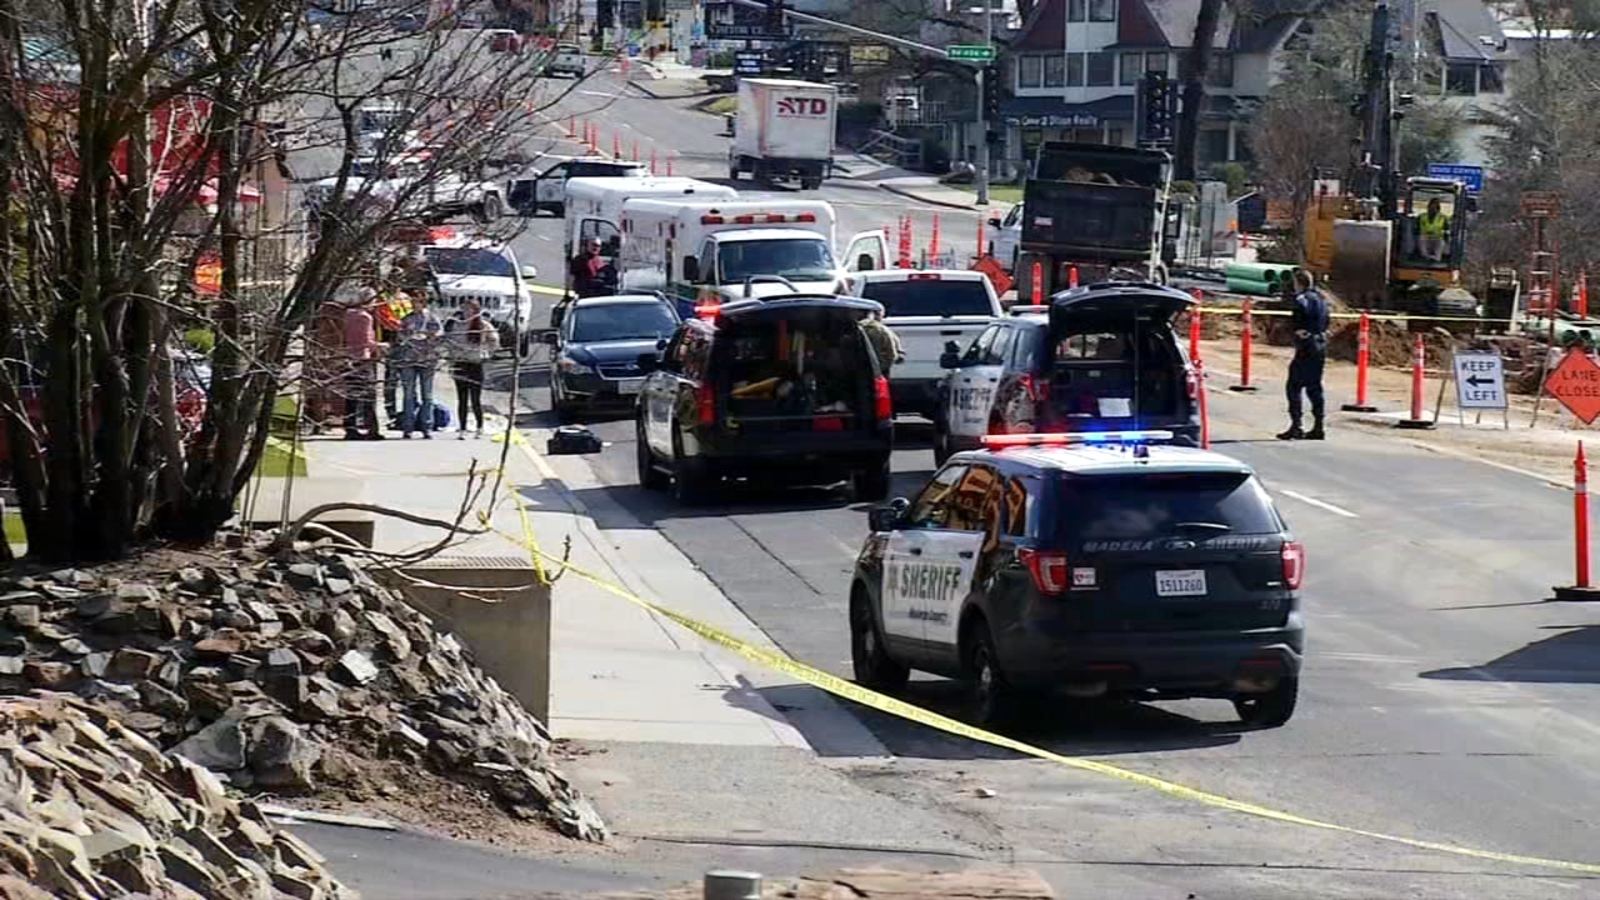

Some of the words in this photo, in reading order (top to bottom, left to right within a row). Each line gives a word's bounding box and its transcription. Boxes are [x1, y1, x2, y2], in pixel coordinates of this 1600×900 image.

[1461, 360, 1495, 372] KEEP
[1561, 370, 1598, 382] LANE
[1465, 390, 1497, 401] LEFT
[1206, 538, 1267, 550] SHERIFF
[901, 564, 961, 600] SHERIFF
